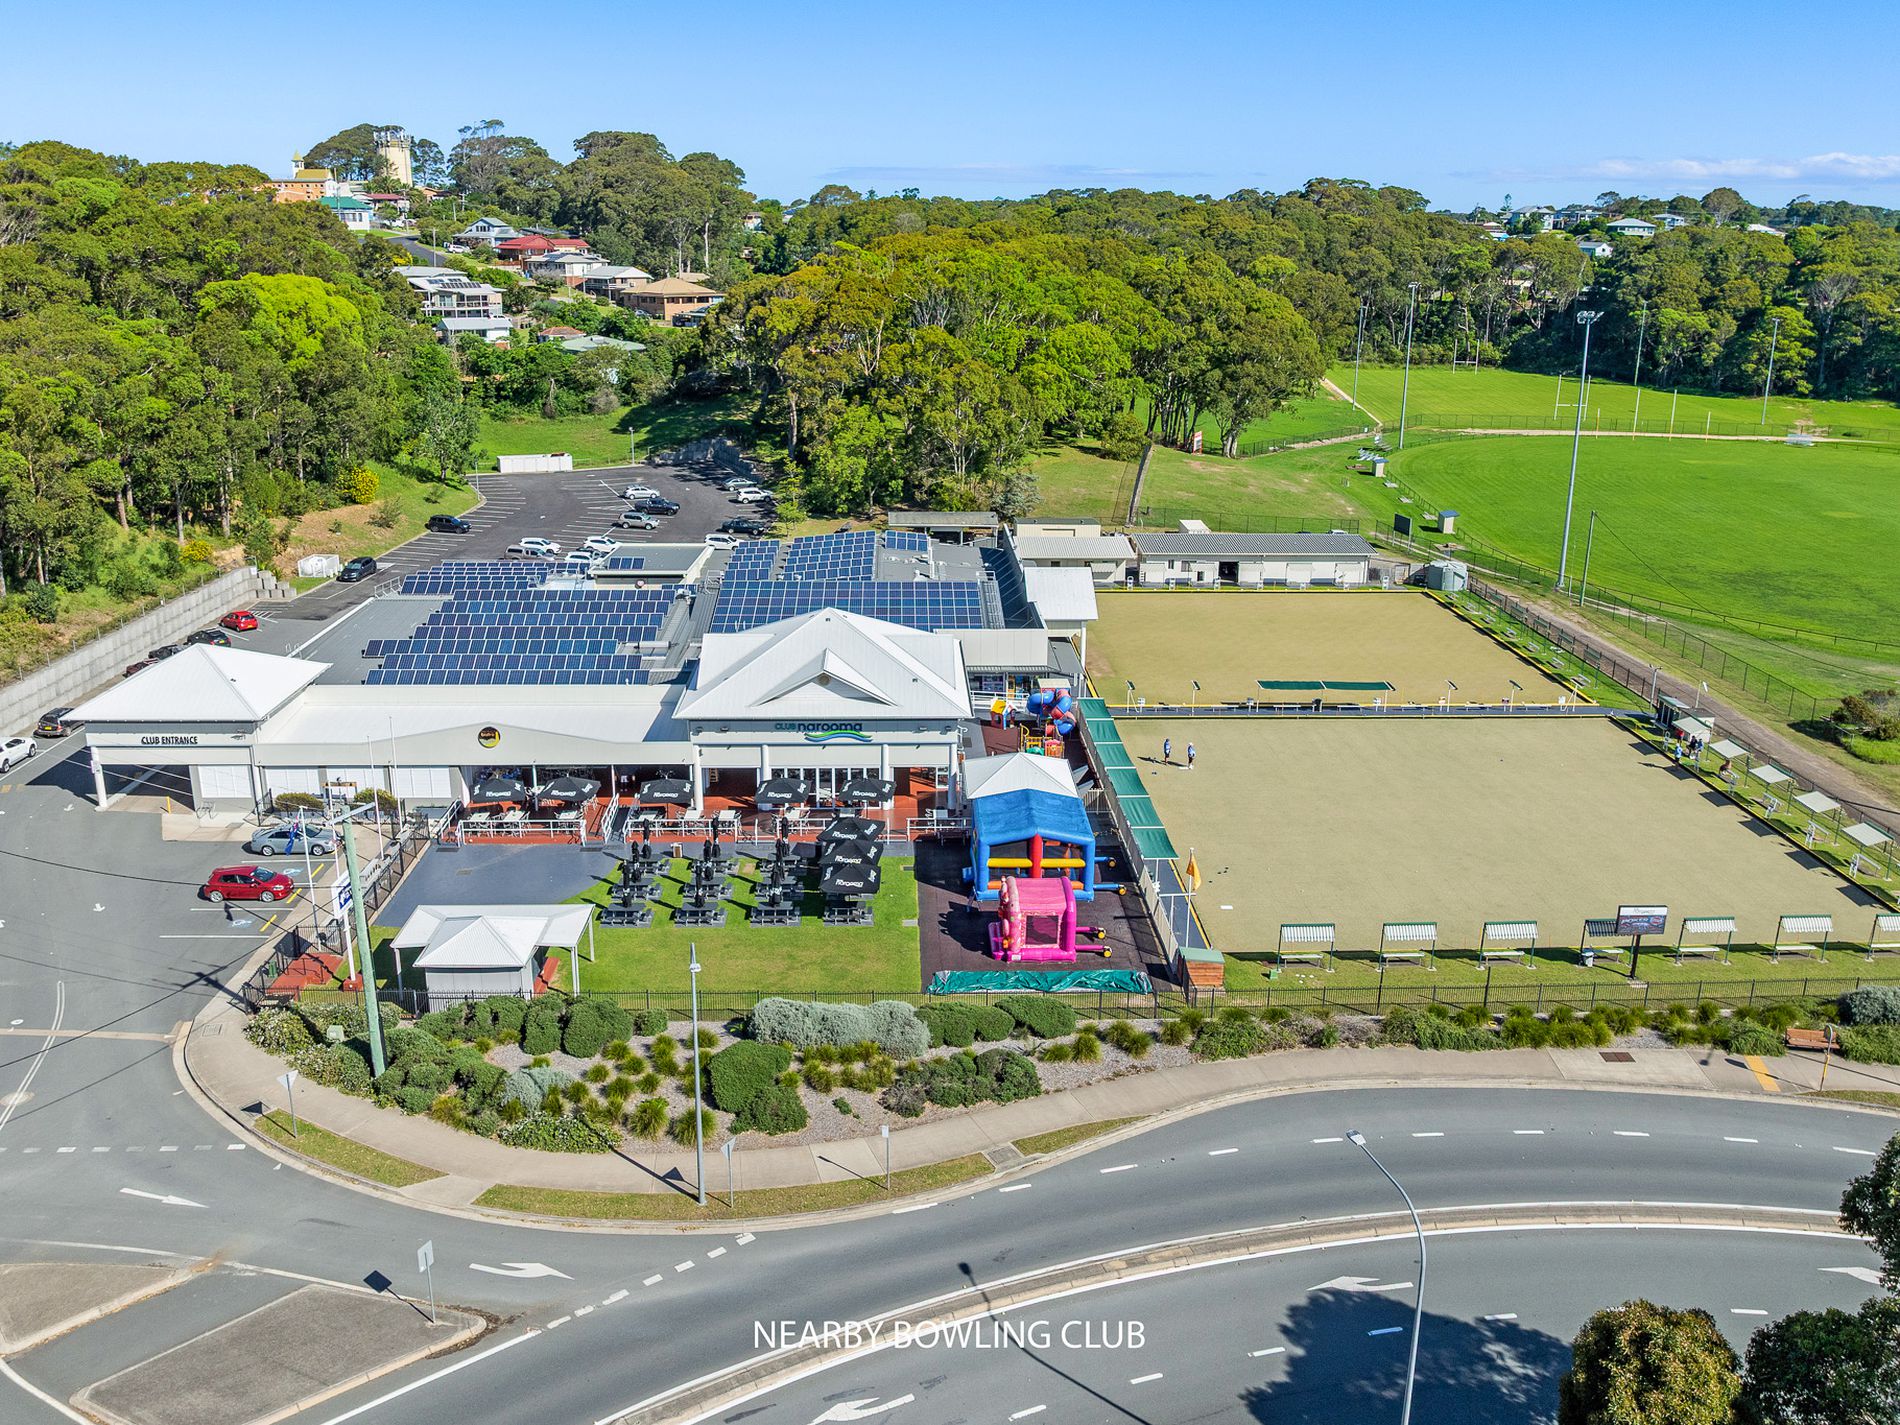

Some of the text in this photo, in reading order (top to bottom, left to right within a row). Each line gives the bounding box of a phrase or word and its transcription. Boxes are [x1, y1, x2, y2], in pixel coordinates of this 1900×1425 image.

[775, 722, 863, 732] CLUB narooma
[141, 736, 198, 745] CLUB ENTRANCE
